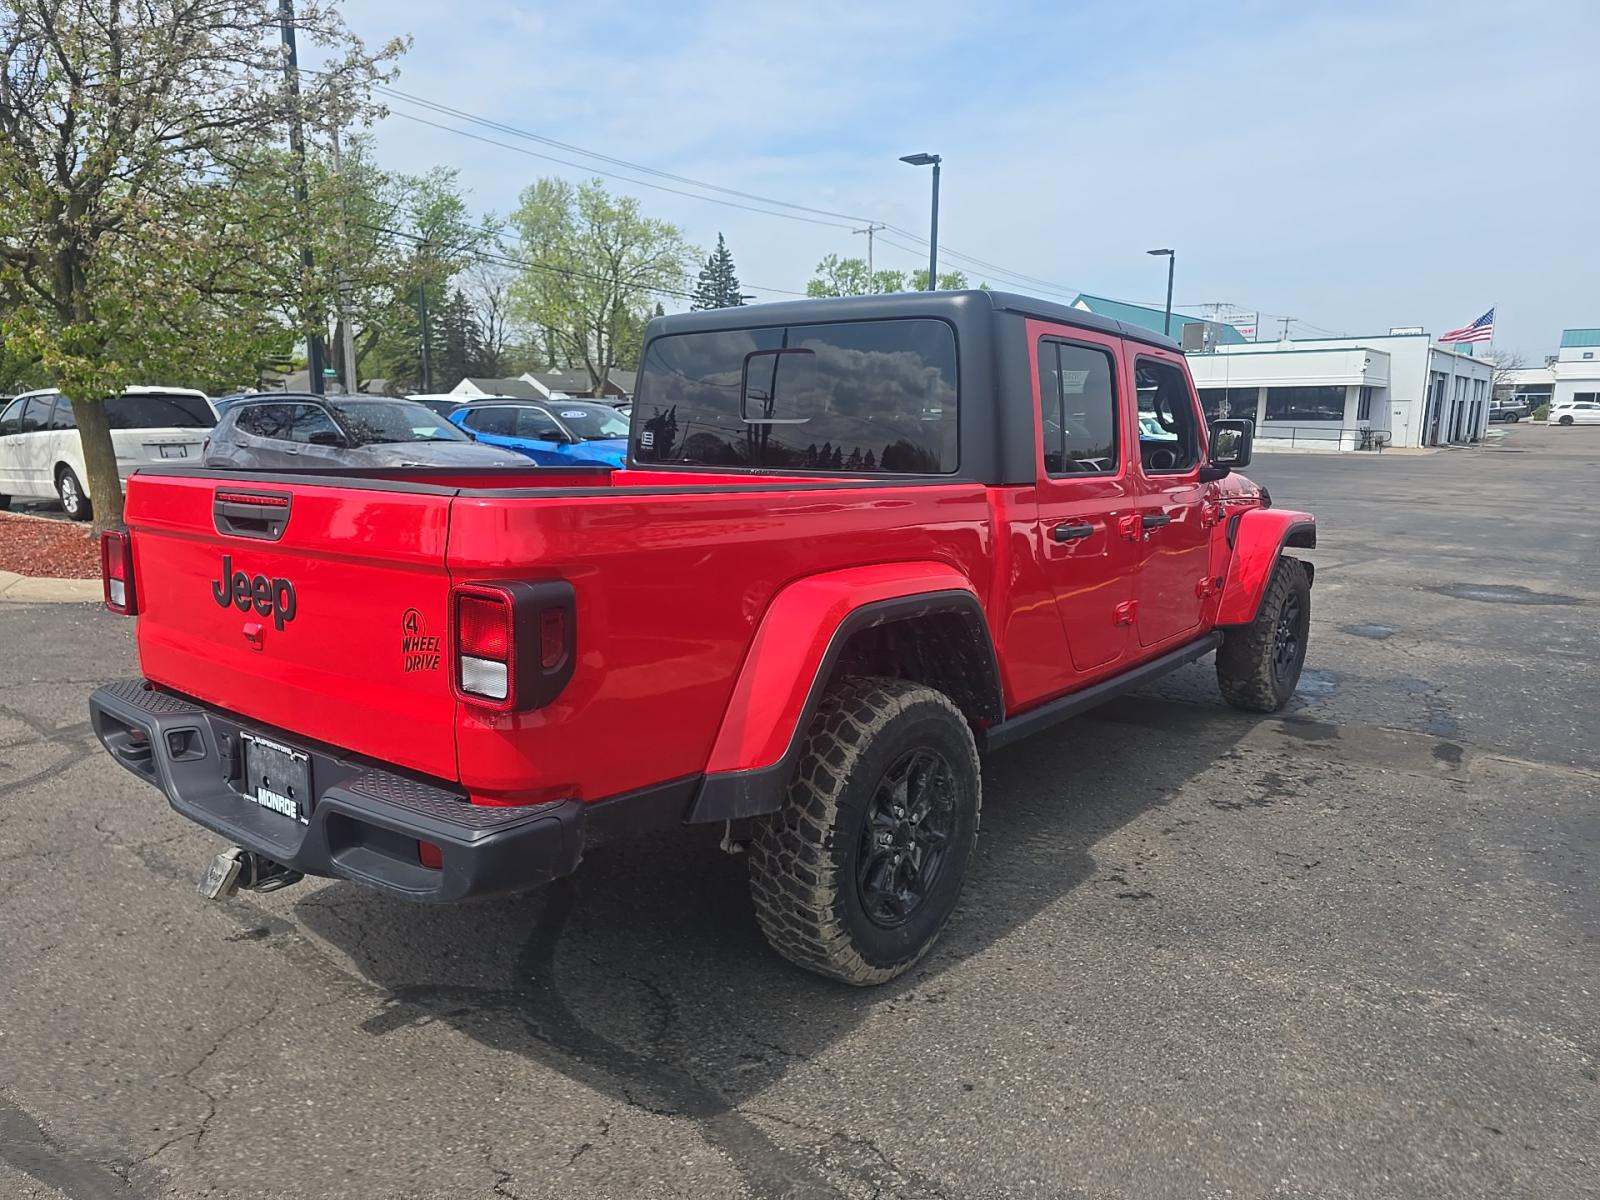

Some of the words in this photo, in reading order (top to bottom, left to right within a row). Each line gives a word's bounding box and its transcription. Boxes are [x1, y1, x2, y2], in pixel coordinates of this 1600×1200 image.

[211, 555, 297, 631] Jeep
[402, 636, 440, 653] WHEEL
[404, 654, 440, 672] DRIVE
[257, 787, 297, 819] MONROE
